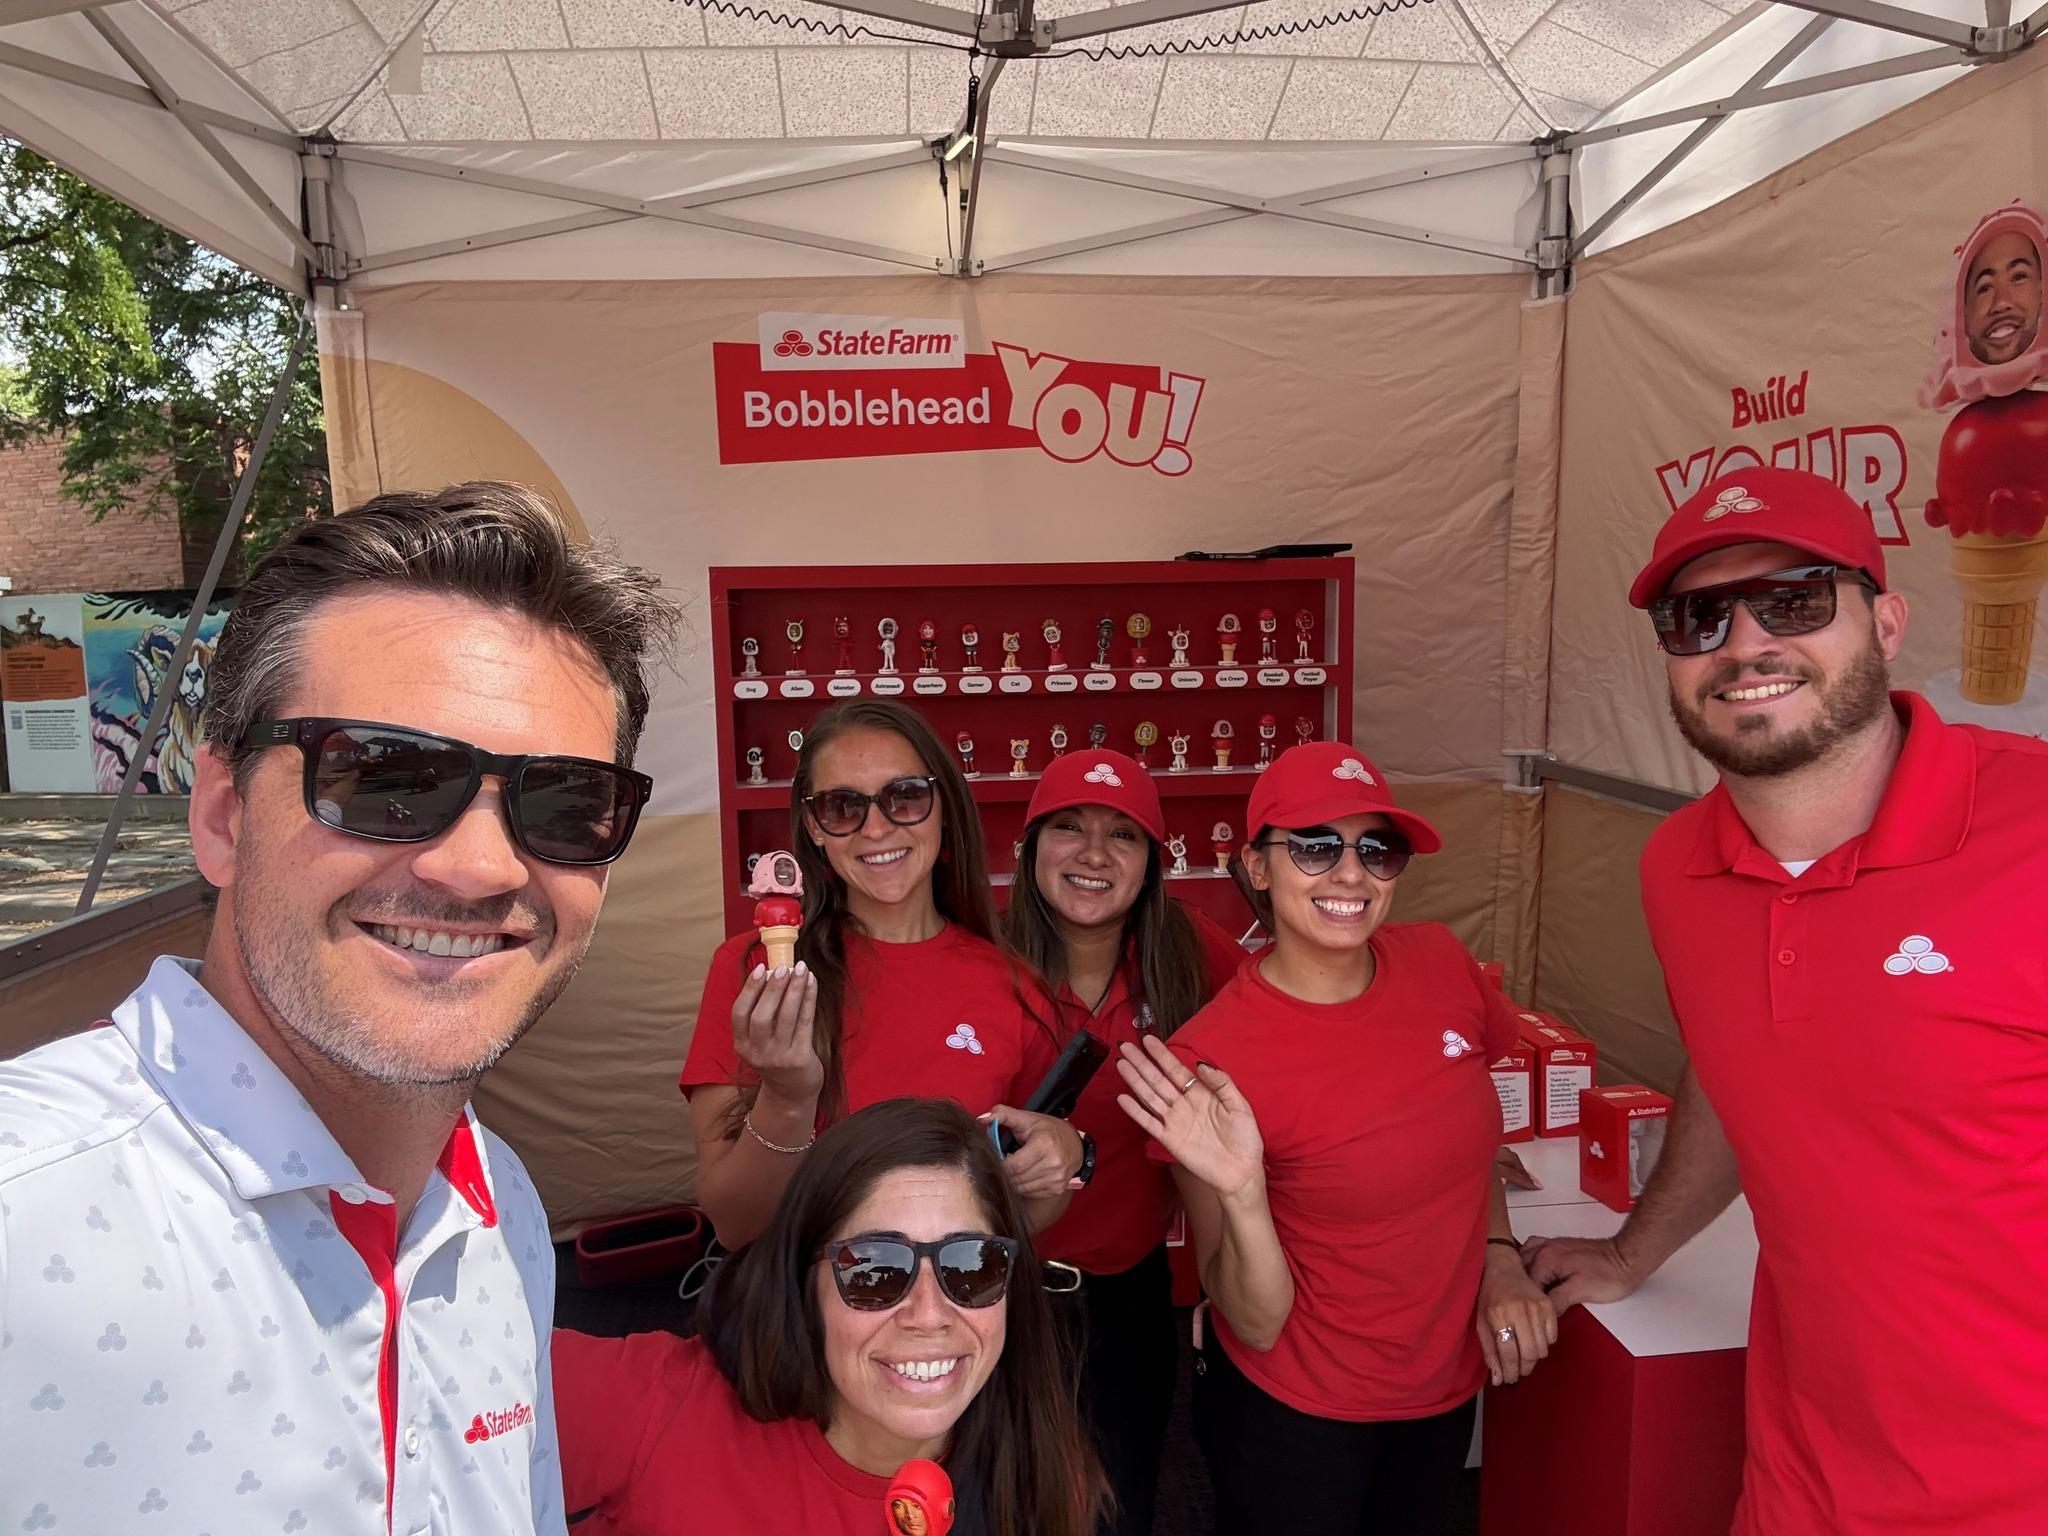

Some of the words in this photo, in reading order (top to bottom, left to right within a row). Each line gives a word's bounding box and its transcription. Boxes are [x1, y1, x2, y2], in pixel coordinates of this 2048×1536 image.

[744, 387, 990, 427] Bobblehead
[991, 340, 1206, 477] YOU!
[1731, 370, 1809, 428] Build
